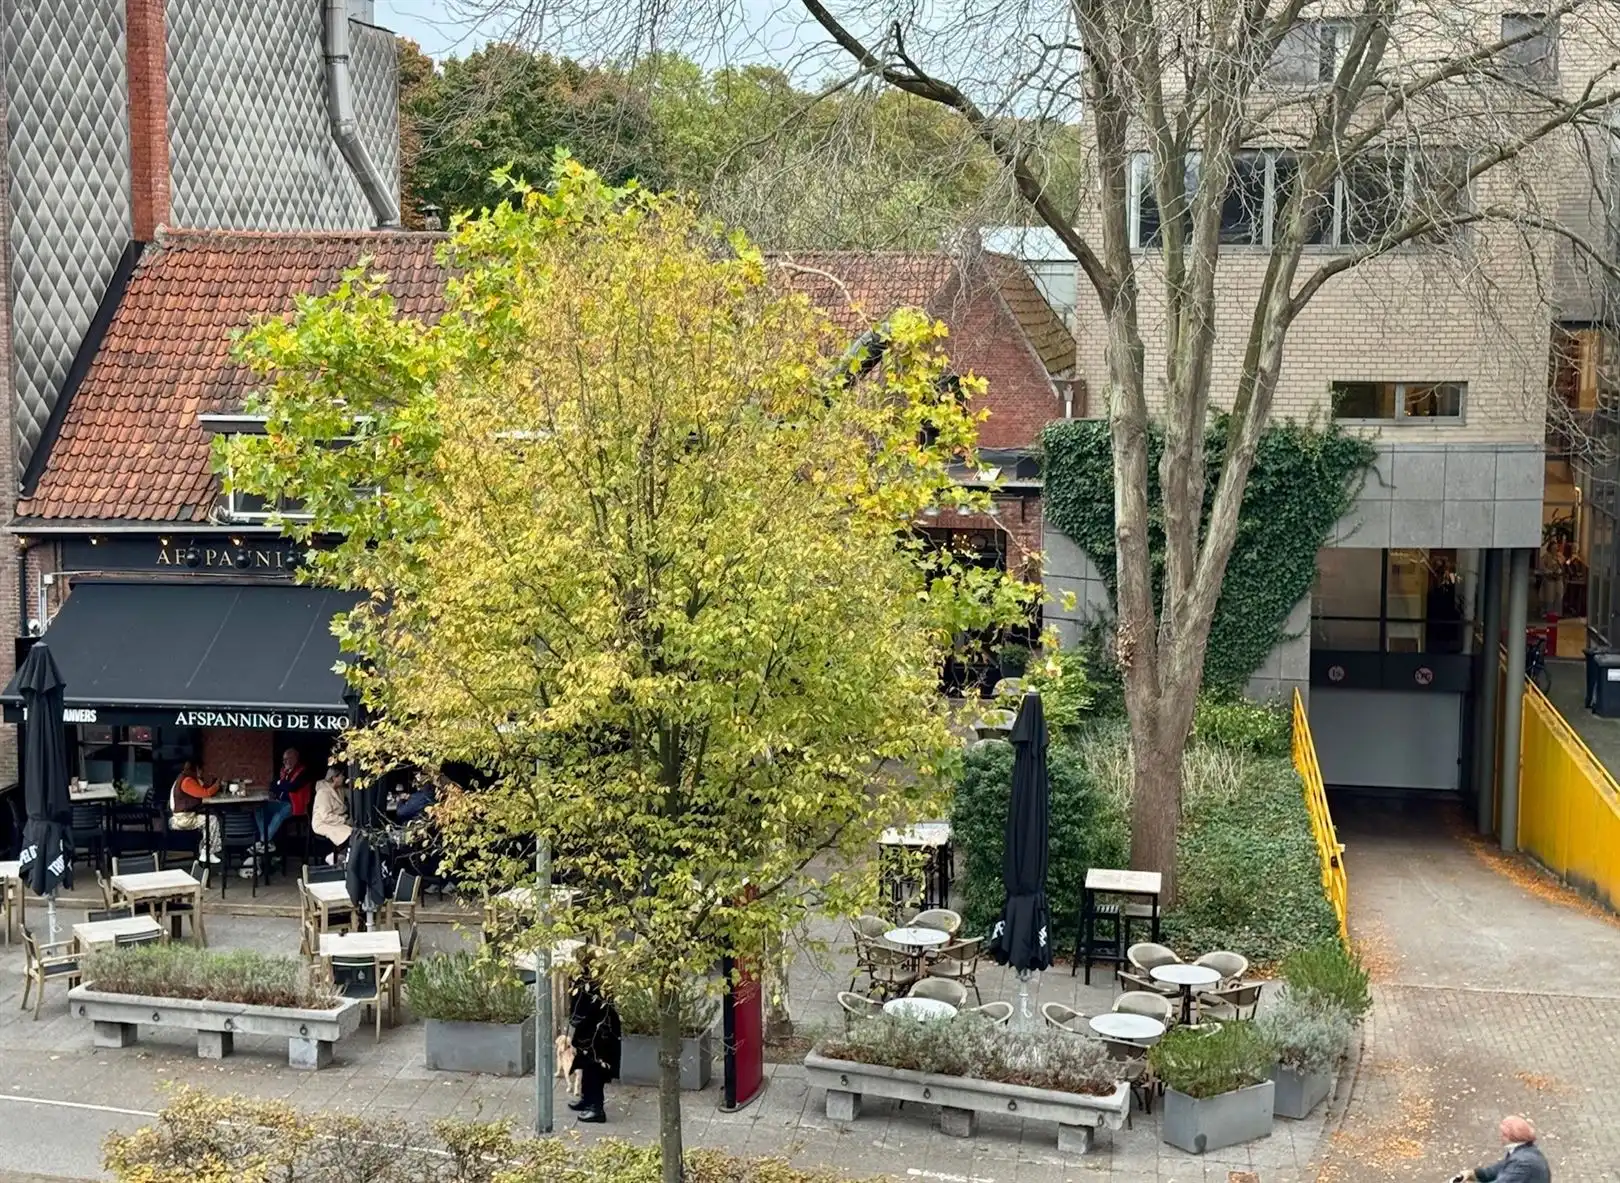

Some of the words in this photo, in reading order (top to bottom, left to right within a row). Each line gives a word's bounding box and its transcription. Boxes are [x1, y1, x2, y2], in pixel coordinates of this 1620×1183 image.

[63, 708, 97, 723] ANVERS
[175, 711, 282, 728] AFSPANNING
[287, 715, 309, 729] DE
[314, 715, 350, 731] KRO
